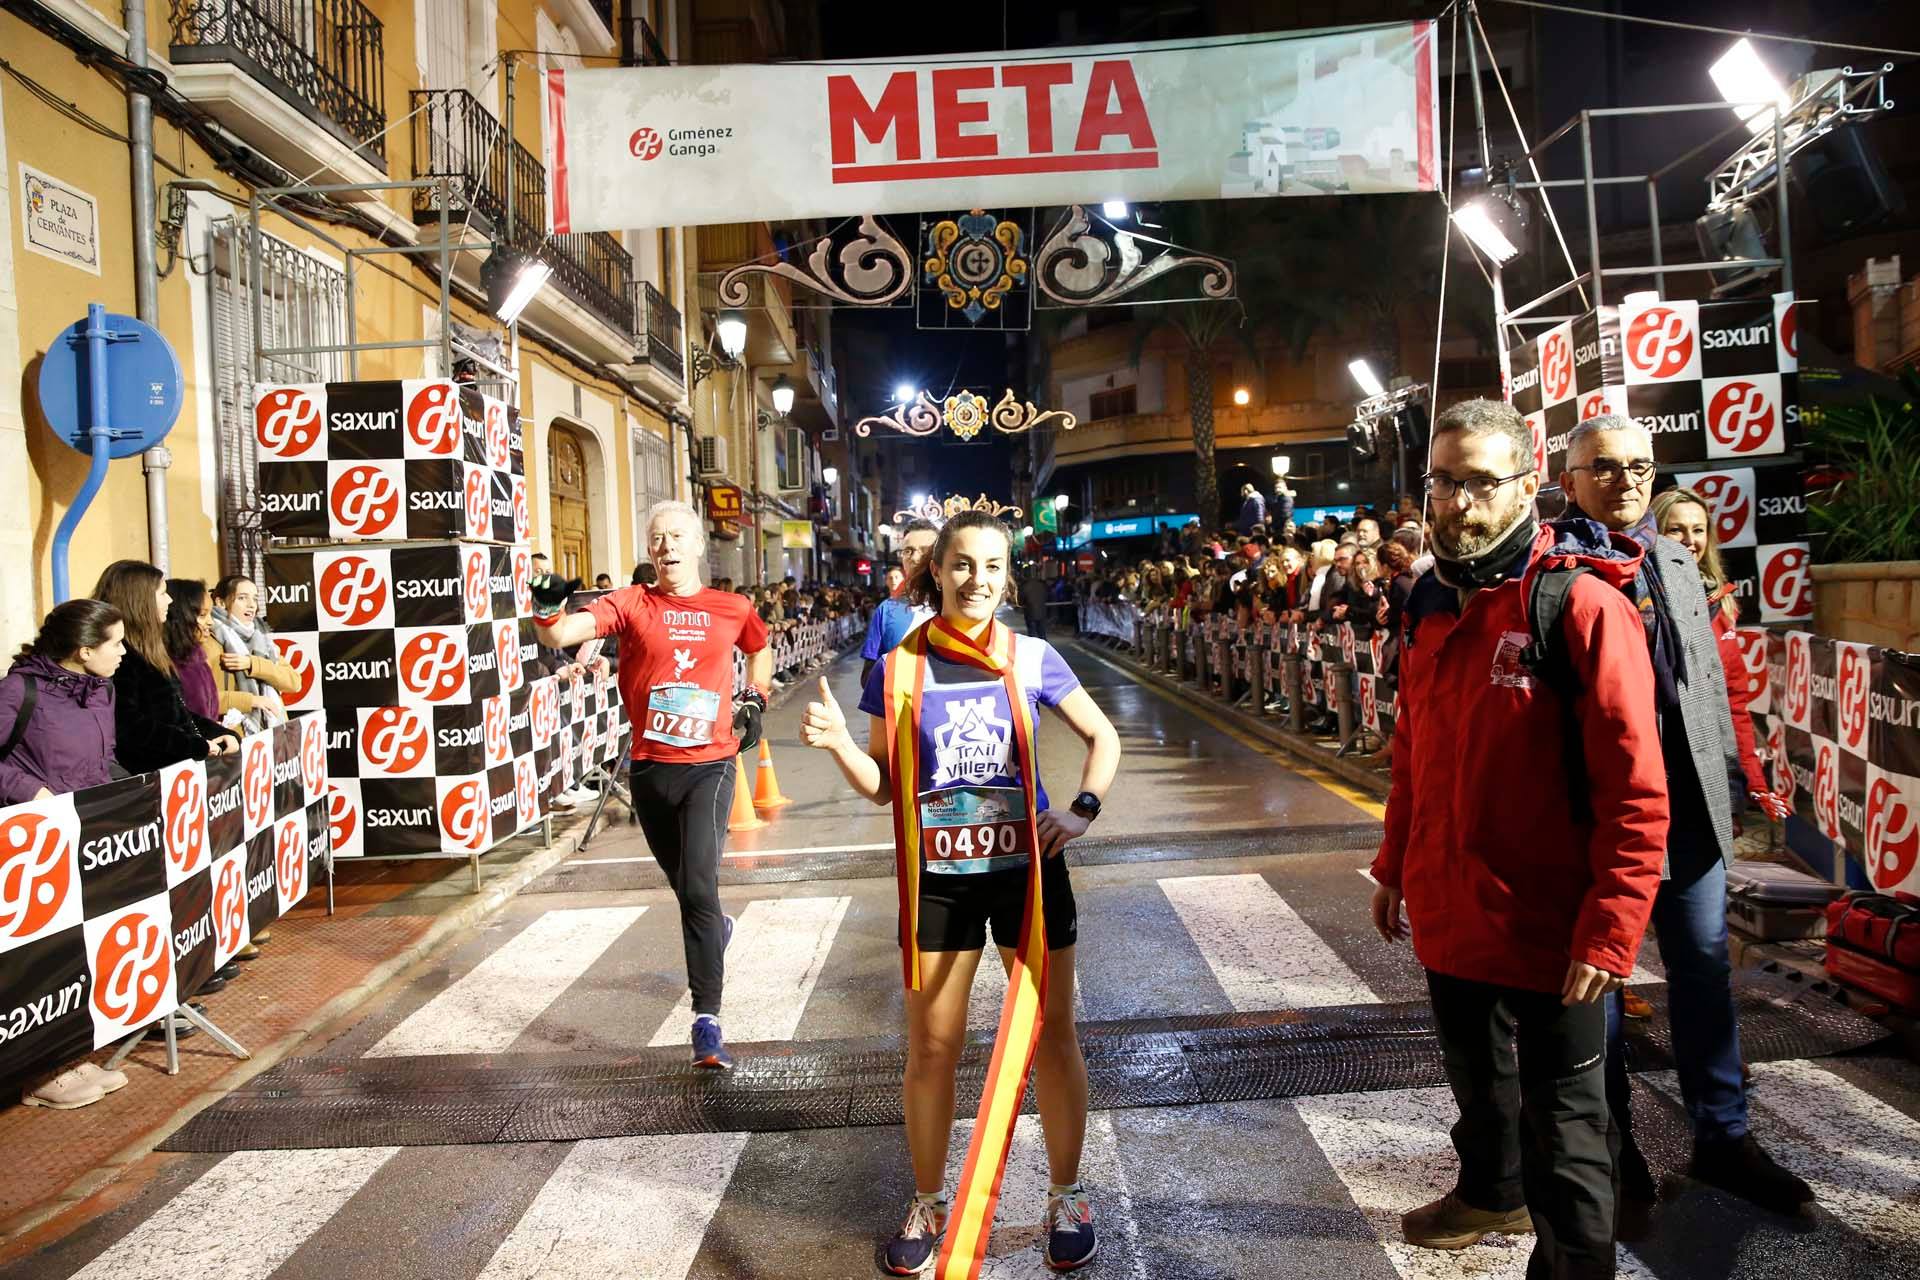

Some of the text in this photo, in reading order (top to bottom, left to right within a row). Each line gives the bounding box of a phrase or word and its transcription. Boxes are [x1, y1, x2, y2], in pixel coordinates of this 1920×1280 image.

[827, 59, 1157, 165] META
[668, 126, 733, 141] Giménez
[669, 143, 715, 157] Ganga
[50, 199, 78, 220] PLAZA
[58, 215, 66, 225] de
[37, 216, 87, 246] CERVANTES
[1702, 326, 1769, 349] saxun
[1511, 367, 1539, 394] saxun
[331, 411, 396, 431] saxun
[463, 415, 484, 439] saxun
[259, 493, 320, 512] saxun
[409, 490, 464, 511] saxun
[491, 496, 512, 518] saxun
[267, 584, 309, 604] xun
[397, 577, 463, 599] saxun
[490, 574, 512, 593] saxun
[325, 660, 389, 681] saxun
[469, 650, 496, 674] saxun
[1811, 673, 1837, 701] saxun
[510, 713, 529, 733] saxun
[652, 712, 708, 741] 0742
[438, 723, 484, 748] saxun
[275, 755, 300, 786] saxun
[208, 783, 241, 821] saxun
[490, 790, 515, 817] saxun
[1839, 793, 1863, 833] saxun
[367, 807, 431, 828] saxun
[83, 821, 160, 872] saxun
[935, 824, 1017, 858] 0490
[248, 866, 275, 904] saxun
[174, 912, 211, 962] saxun
